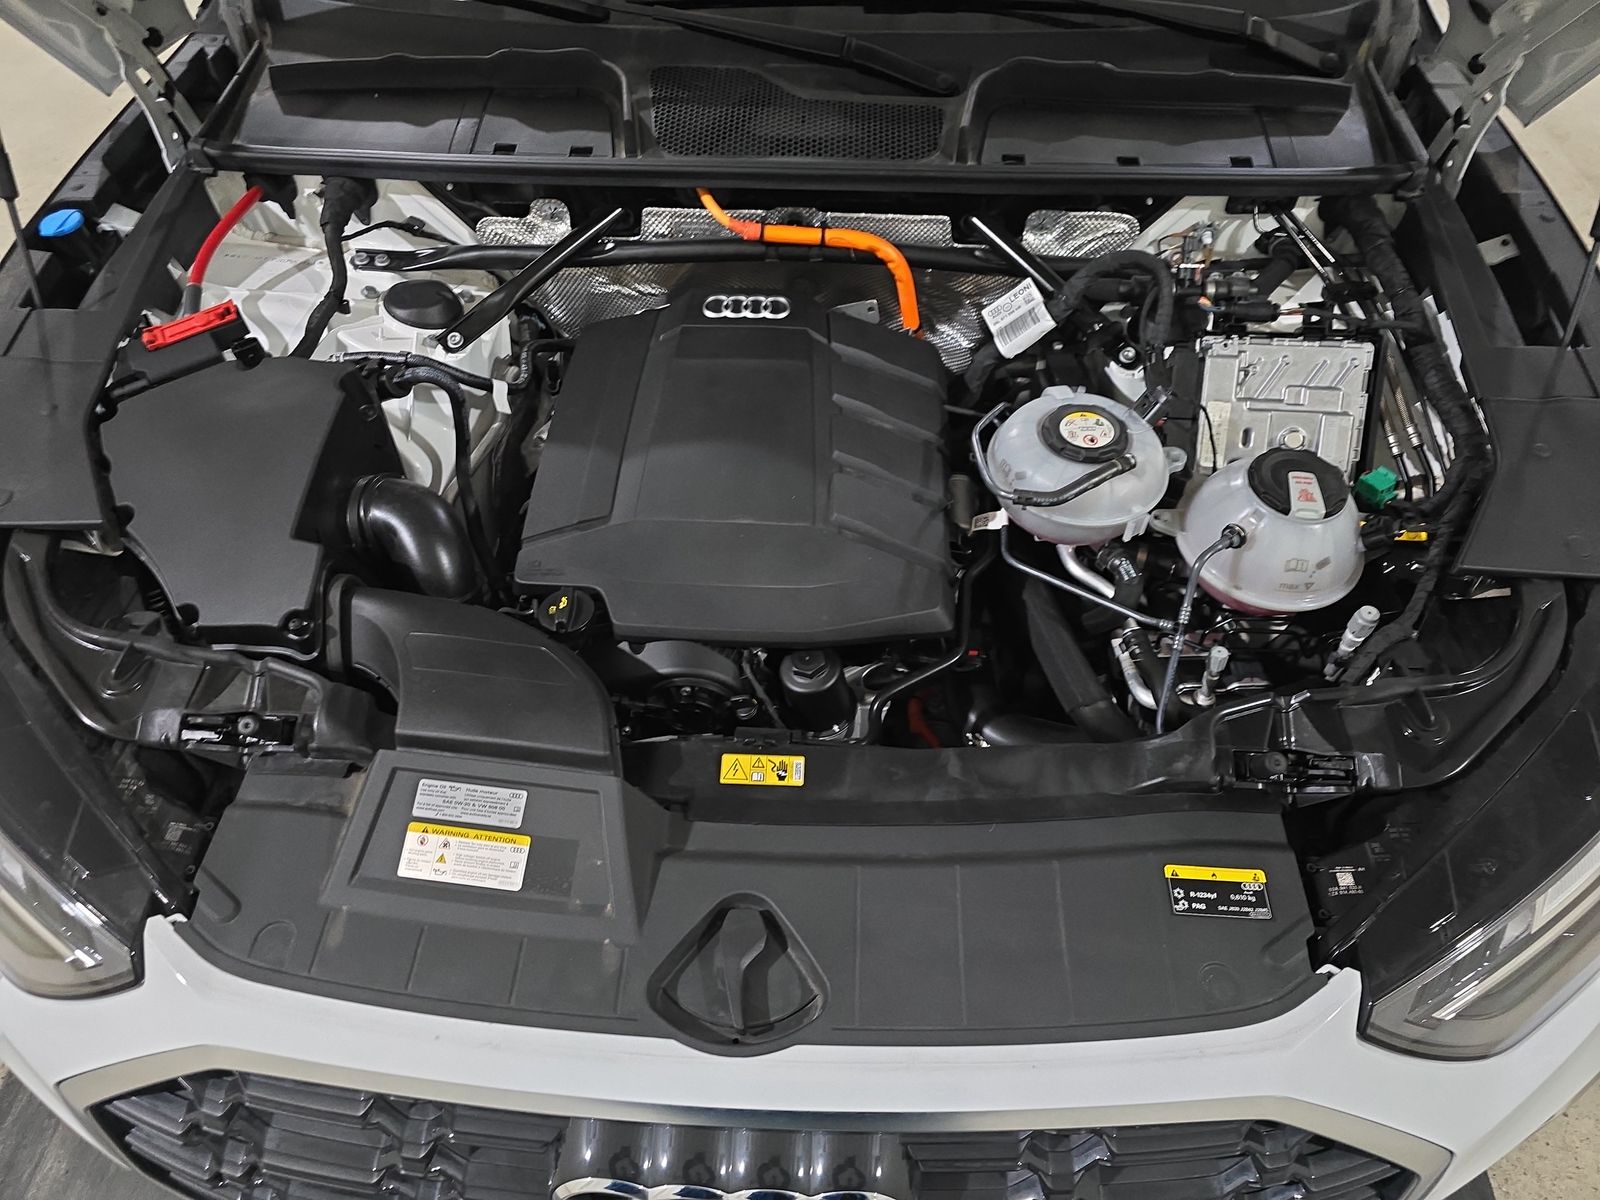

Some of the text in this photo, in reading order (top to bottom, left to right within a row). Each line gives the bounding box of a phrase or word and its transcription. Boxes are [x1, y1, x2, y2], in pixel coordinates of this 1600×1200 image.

[1009, 283, 1032, 302] LEONI
[421, 782, 439, 790] Engine
[431, 828, 516, 844] WARNING ATTENTION
[1191, 902, 1207, 910] PAG
